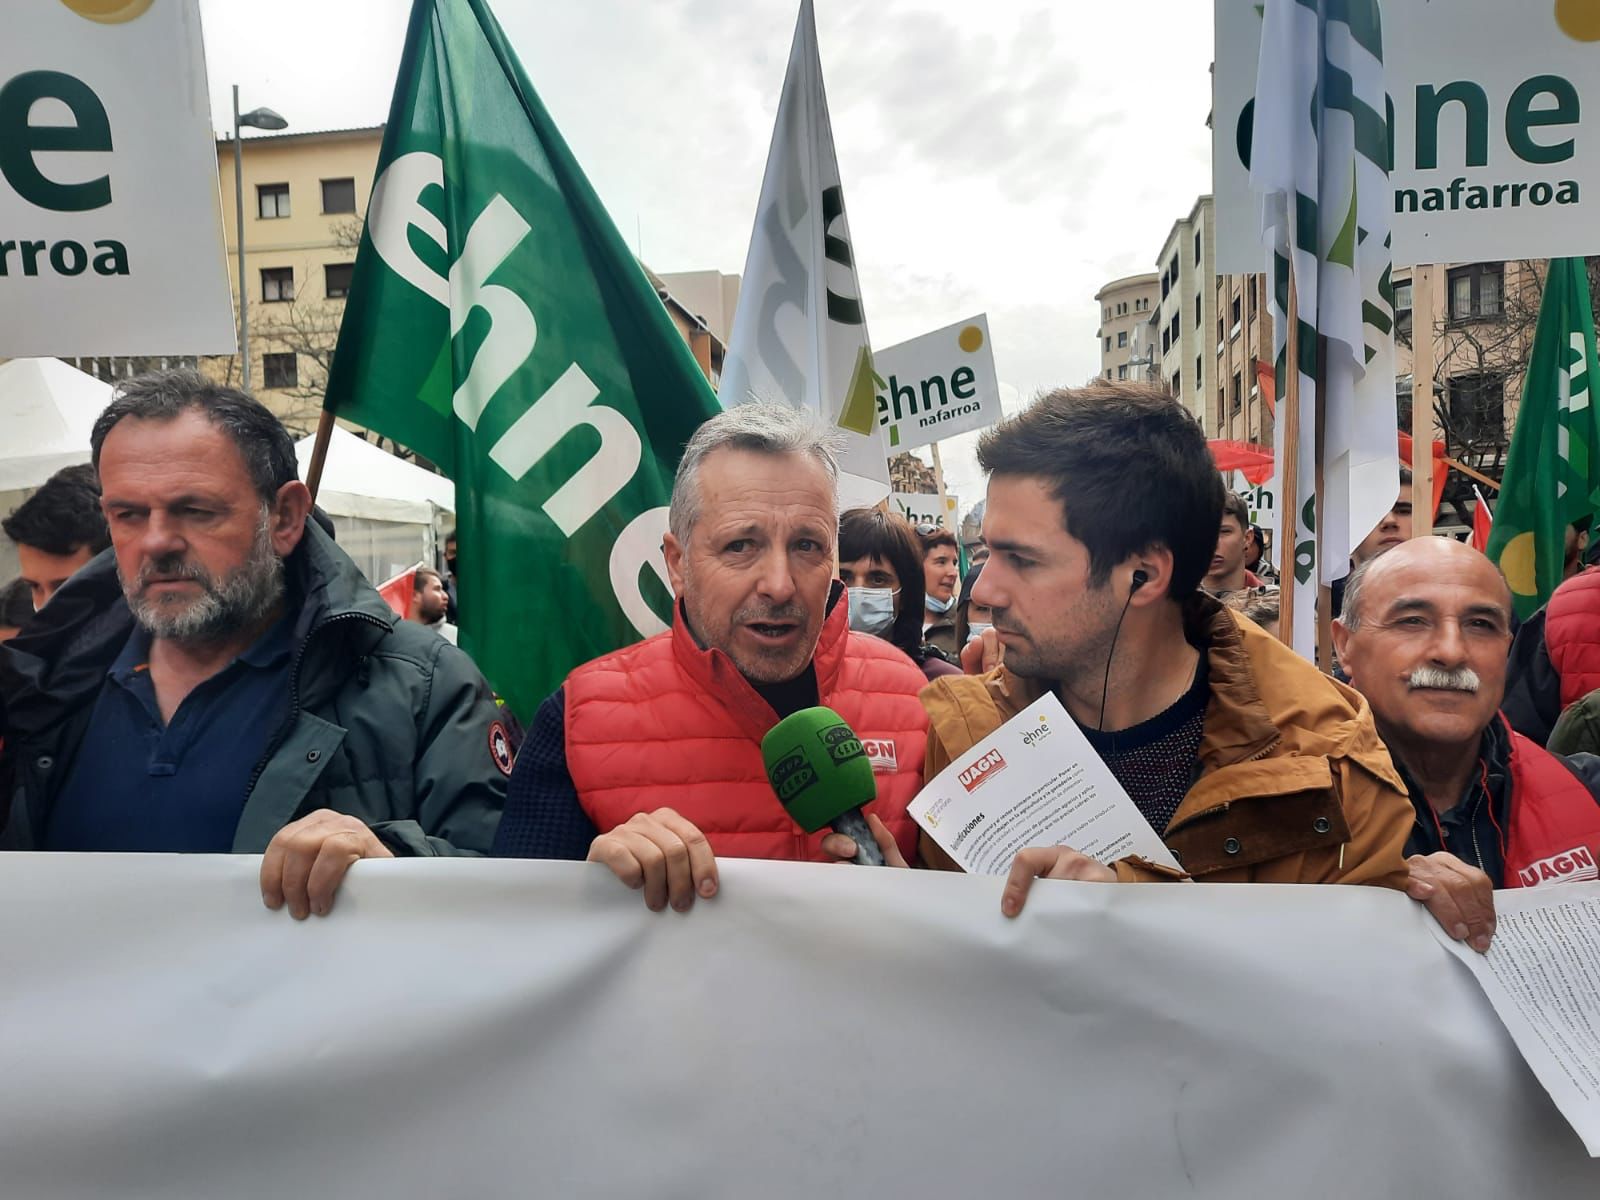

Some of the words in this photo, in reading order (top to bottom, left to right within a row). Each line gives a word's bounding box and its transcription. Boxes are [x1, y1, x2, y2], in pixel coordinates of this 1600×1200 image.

[1394, 177, 1581, 213] nafarroa
[919, 401, 981, 428] nafarroa
[1023, 724, 1049, 745] ehne
[959, 750, 1002, 786] UAGN
[1520, 849, 1592, 888] UAGN
